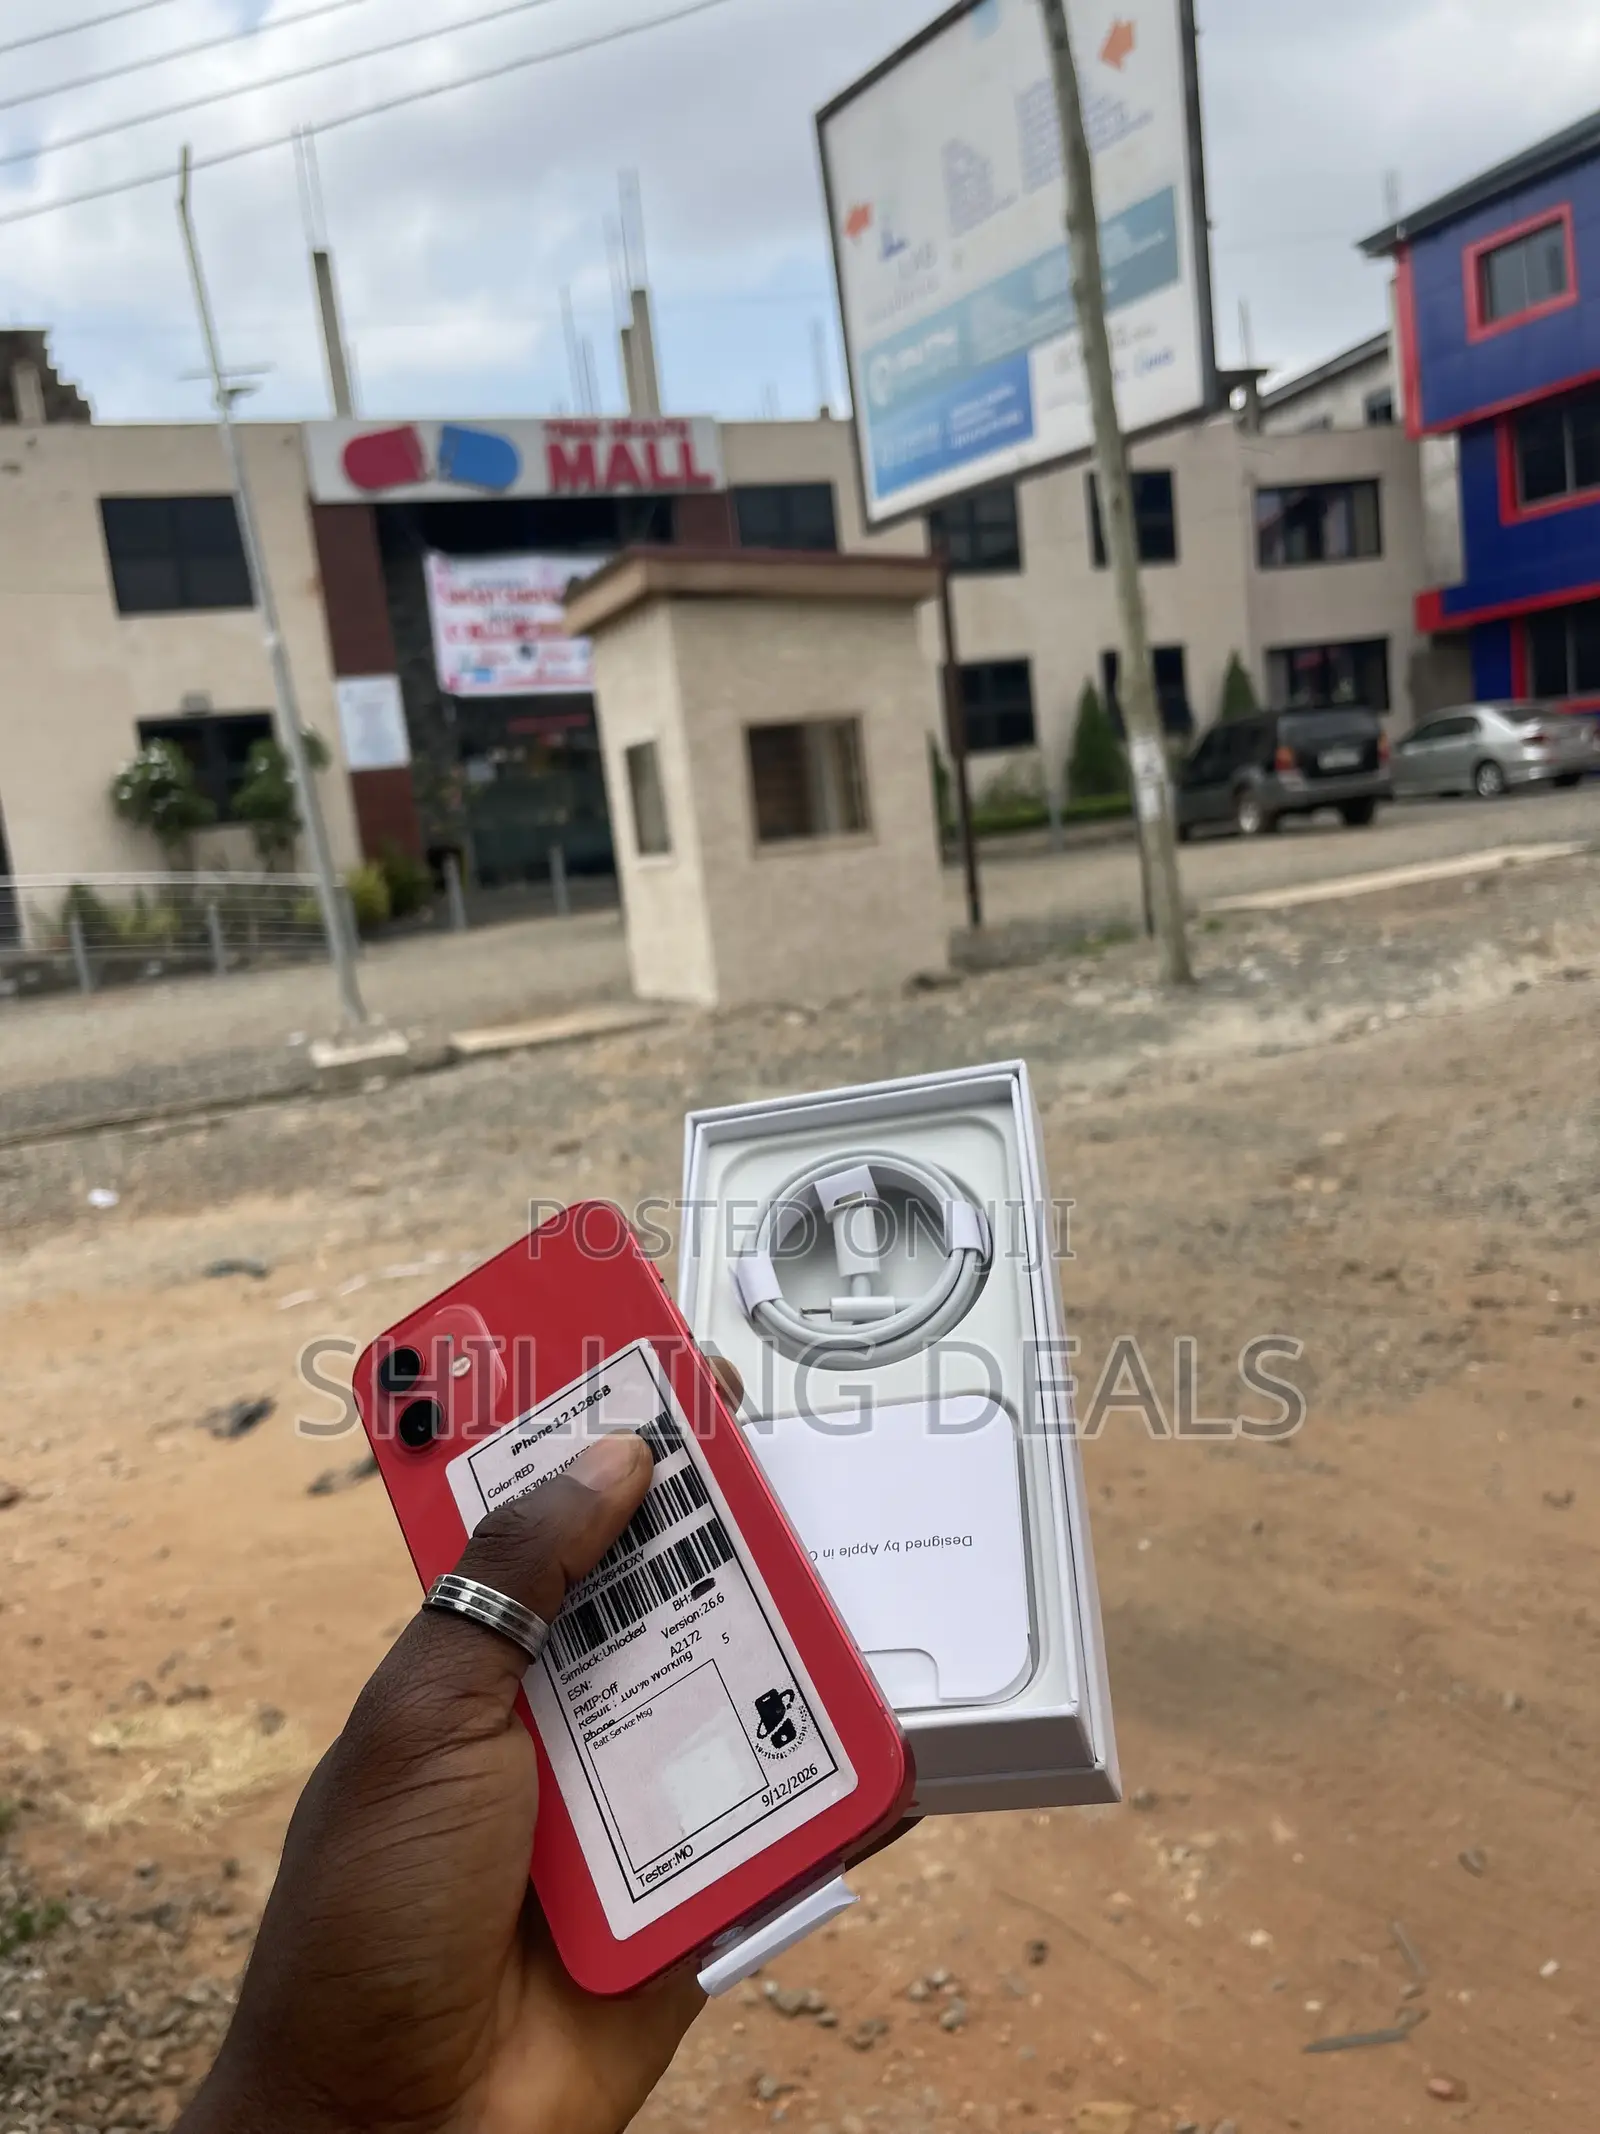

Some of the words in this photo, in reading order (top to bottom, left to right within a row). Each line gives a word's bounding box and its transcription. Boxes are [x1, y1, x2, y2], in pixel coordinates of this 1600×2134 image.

[546, 441, 715, 491] MALL
[510, 1424, 554, 1456] iPhone
[487, 1463, 536, 1499] Color:RED
[822, 1548, 835, 1560] in
[839, 1541, 879, 1556] Apple
[883, 1539, 900, 1553] by
[905, 1535, 973, 1552] Designed
[661, 1592, 725, 1639] Version:26.6
[560, 1622, 647, 1685] Simlock:Unlocked
[670, 1630, 703, 1657] A2172
[722, 1632, 730, 1645] 5
[567, 1680, 593, 1702] ESN:
[573, 1681, 619, 1719] FMIP:Off
[592, 1733, 610, 1750] Batt
[610, 1718, 636, 1740] Service
[635, 1707, 654, 1722] Msg
[761, 1763, 819, 1807] 9/12/2026
[636, 1844, 694, 1887] Tester:MO
